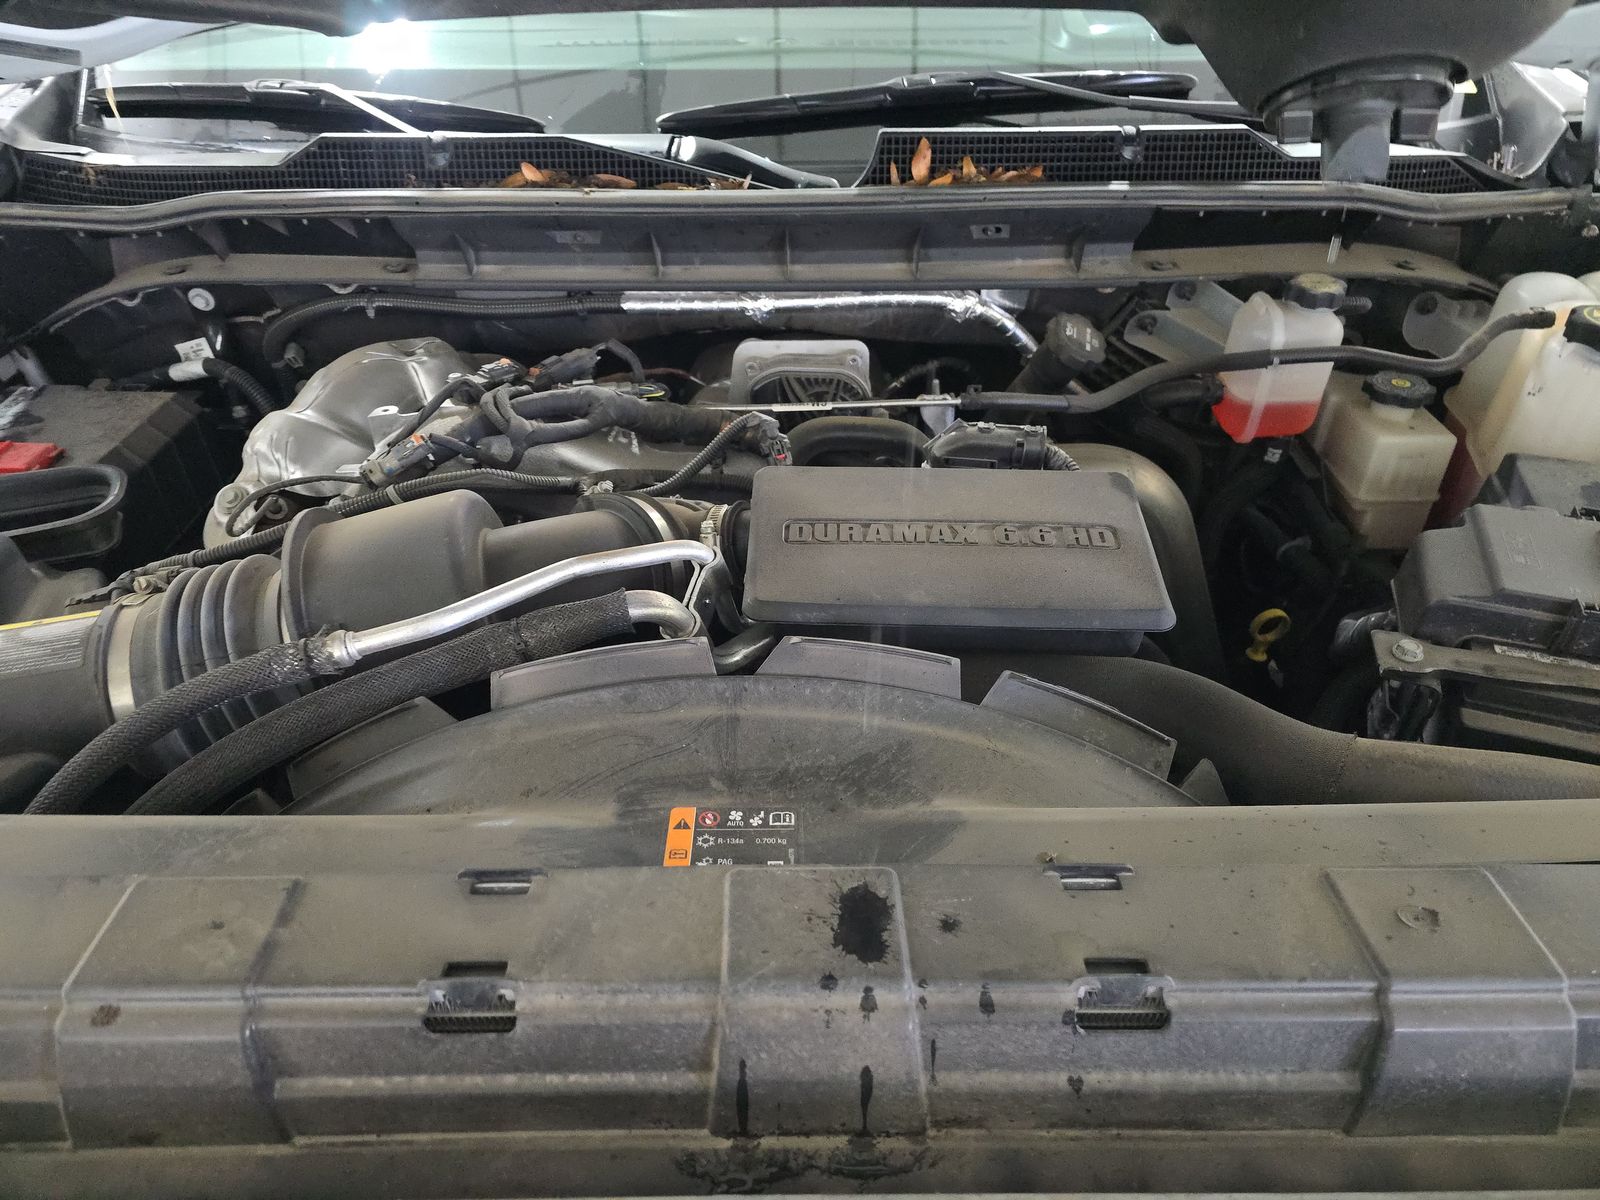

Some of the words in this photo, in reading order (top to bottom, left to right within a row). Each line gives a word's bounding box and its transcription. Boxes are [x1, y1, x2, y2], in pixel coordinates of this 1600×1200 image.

[788, 522, 979, 545] DURAMAX
[994, 524, 1056, 546] 6.6
[1062, 525, 1117, 548] HD
[777, 837, 787, 845] kg
